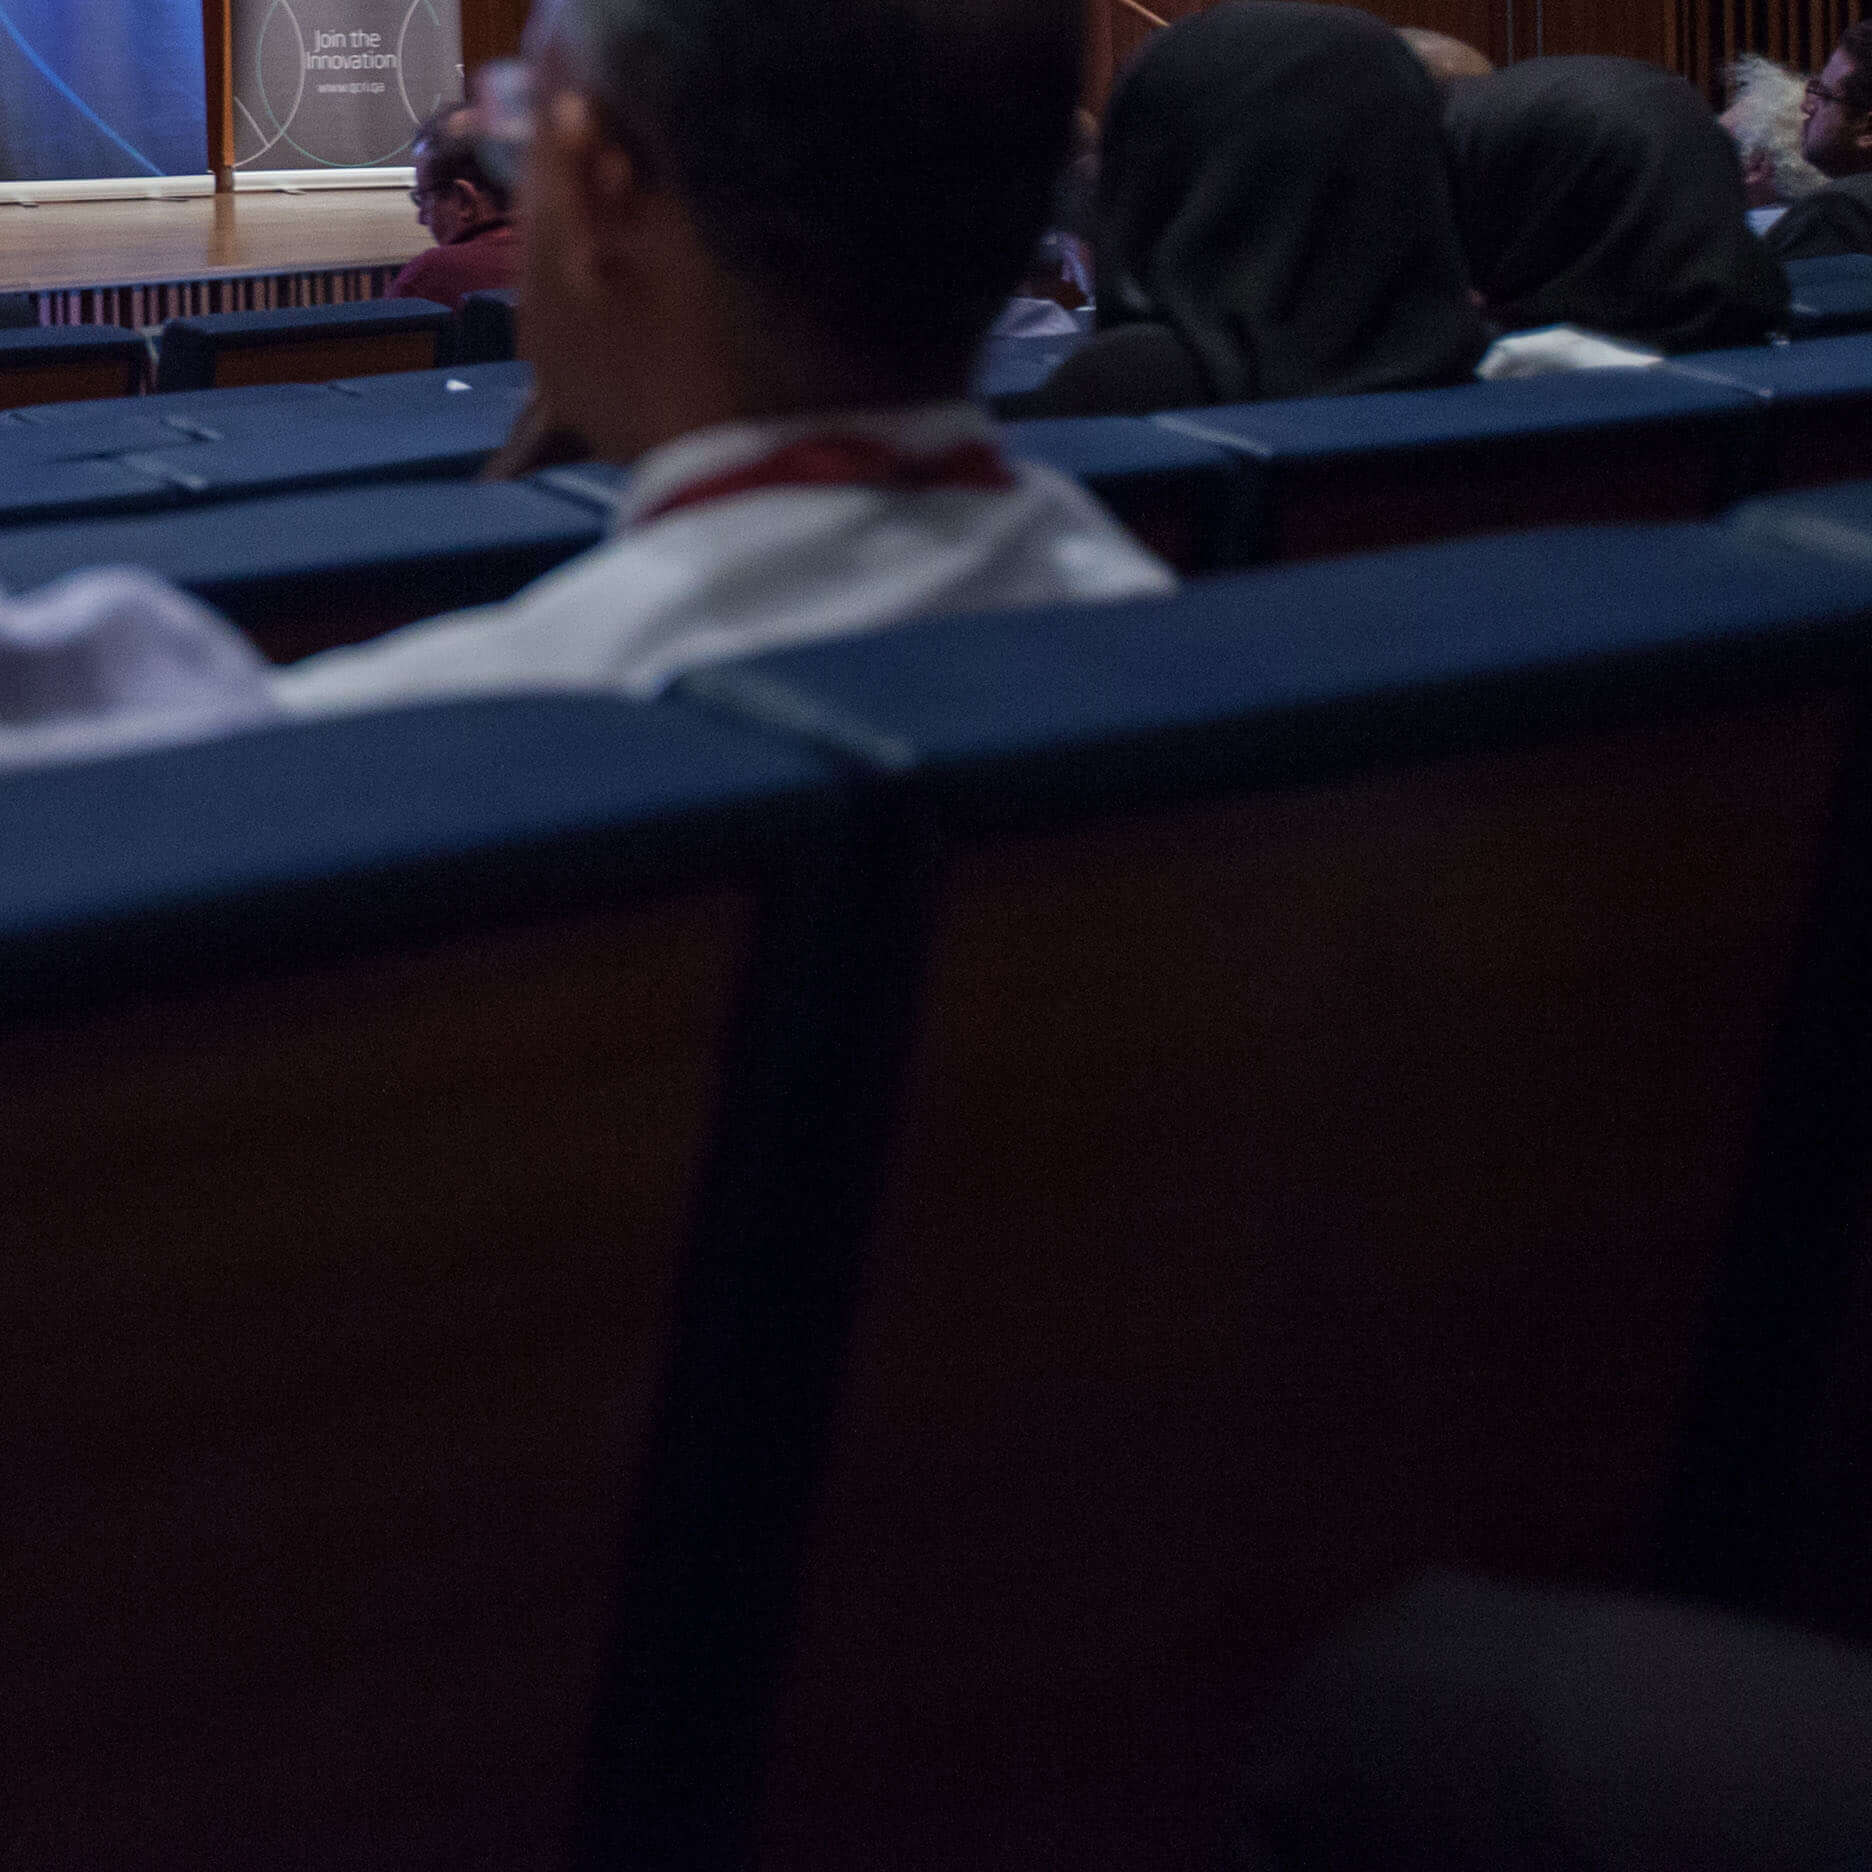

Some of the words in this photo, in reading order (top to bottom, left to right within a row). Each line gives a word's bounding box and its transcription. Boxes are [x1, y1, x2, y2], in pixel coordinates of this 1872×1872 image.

[313, 28, 347, 53] Join
[348, 28, 382, 49] the
[305, 50, 397, 70] Innovation
